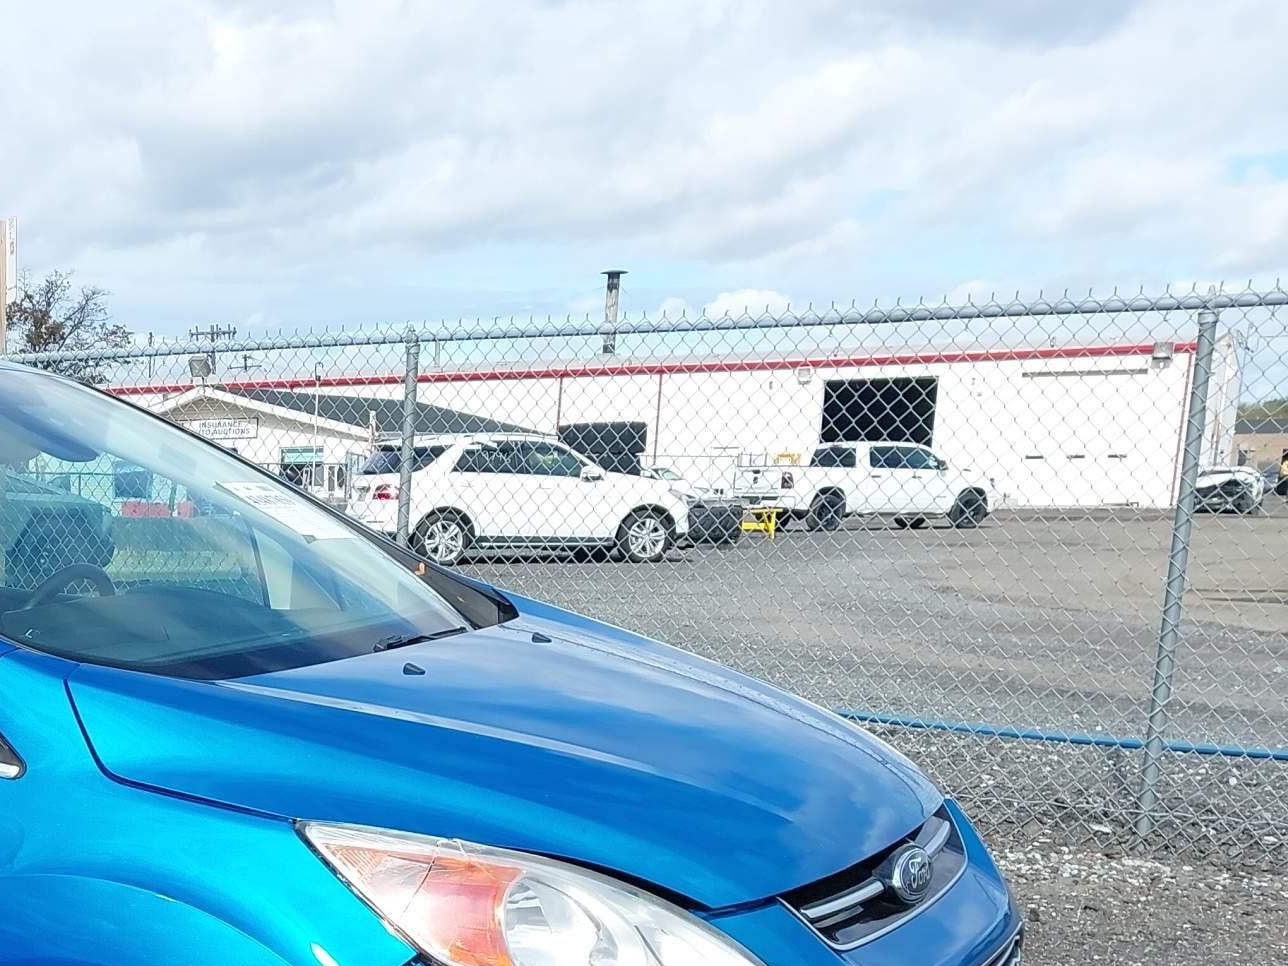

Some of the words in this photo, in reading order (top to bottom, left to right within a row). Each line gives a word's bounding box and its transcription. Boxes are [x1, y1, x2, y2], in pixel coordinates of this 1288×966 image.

[199, 419, 242, 429] INSURANCE
[211, 427, 251, 437] AUCTIONS
[908, 856, 931, 889] Ford
